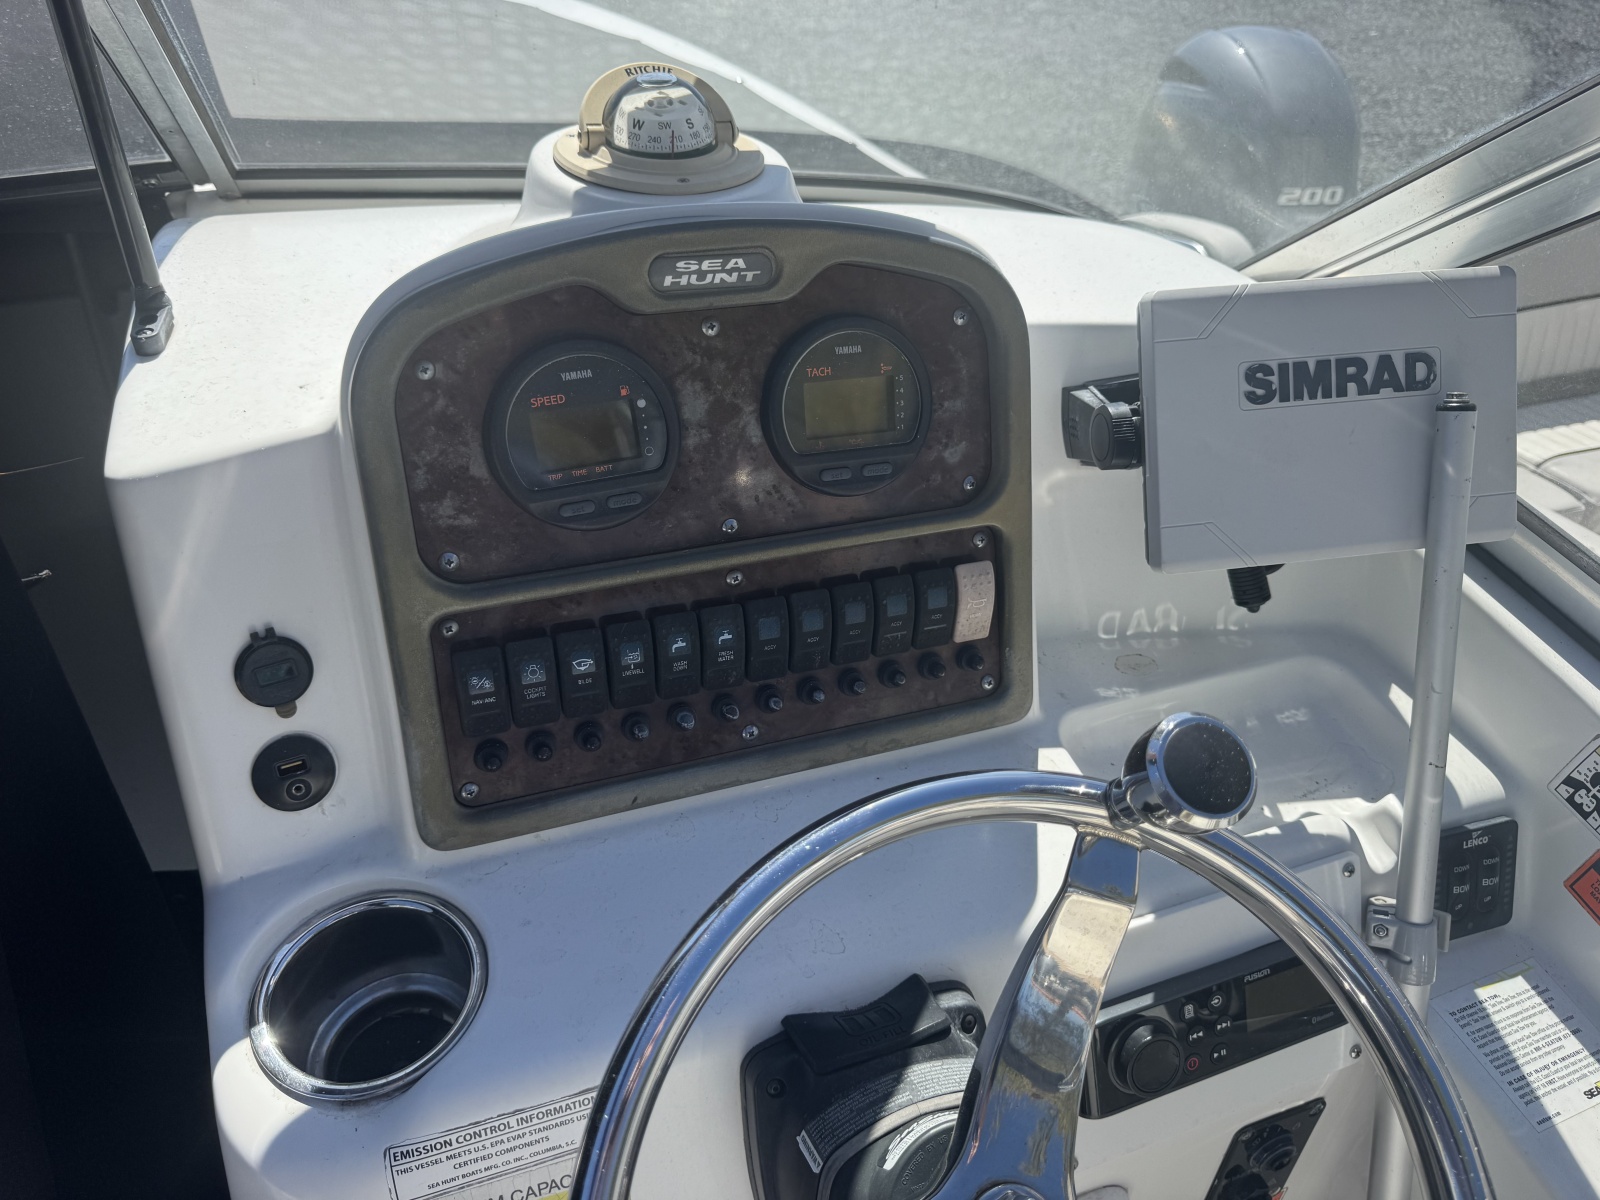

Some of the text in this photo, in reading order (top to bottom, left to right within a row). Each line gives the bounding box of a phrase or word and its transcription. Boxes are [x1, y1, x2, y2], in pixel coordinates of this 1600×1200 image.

[625, 66, 673, 77] RITCHIE
[632, 118, 645, 131] W
[686, 118, 694, 129] S
[628, 132, 640, 141] 270
[690, 131, 700, 140] 180
[1277, 186, 1344, 206] 200
[675, 258, 746, 272] SEA
[663, 271, 761, 286] HUNT
[834, 345, 862, 355] YAMAHA
[560, 369, 592, 381] YAMAHA
[806, 367, 831, 377] TACH
[1244, 352, 1437, 405] SIMRAD
[530, 394, 566, 408] SPEED
[595, 465, 612, 473] BATT
[613, 497, 638, 507] mode
[622, 668, 644, 676] LIVEWELL
[524, 686, 547, 695] COCKPIT
[1463, 836, 1488, 848] LENCO
[1456, 1002, 1479, 1014] CONTACT
[859, 1027, 907, 1047] OIL FILL
[1513, 1075, 1527, 1083] CASE
[1533, 1064, 1552, 1074] INJURY
[392, 1095, 597, 1162] EMISSION CONTROL INFORMATION
[395, 1112, 590, 1176] THIS VESSEL MEETS U.S. EPA EVAP STANDARDS USI
[453, 1135, 550, 1170] CERTIFIED COMPONENTS
[427, 1182, 440, 1190] SEA
[441, 1175, 461, 1186] HUNT
[461, 1168, 483, 1180] BOATS
[484, 1162, 501, 1173] MFG.
[501, 1159, 512, 1167] CO.
[529, 1143, 565, 1159] COLUMBIA,
[566, 1139, 578, 1148] S.C.
[902, 1151, 924, 1186] COVERED
[926, 1141, 936, 1152] BY
